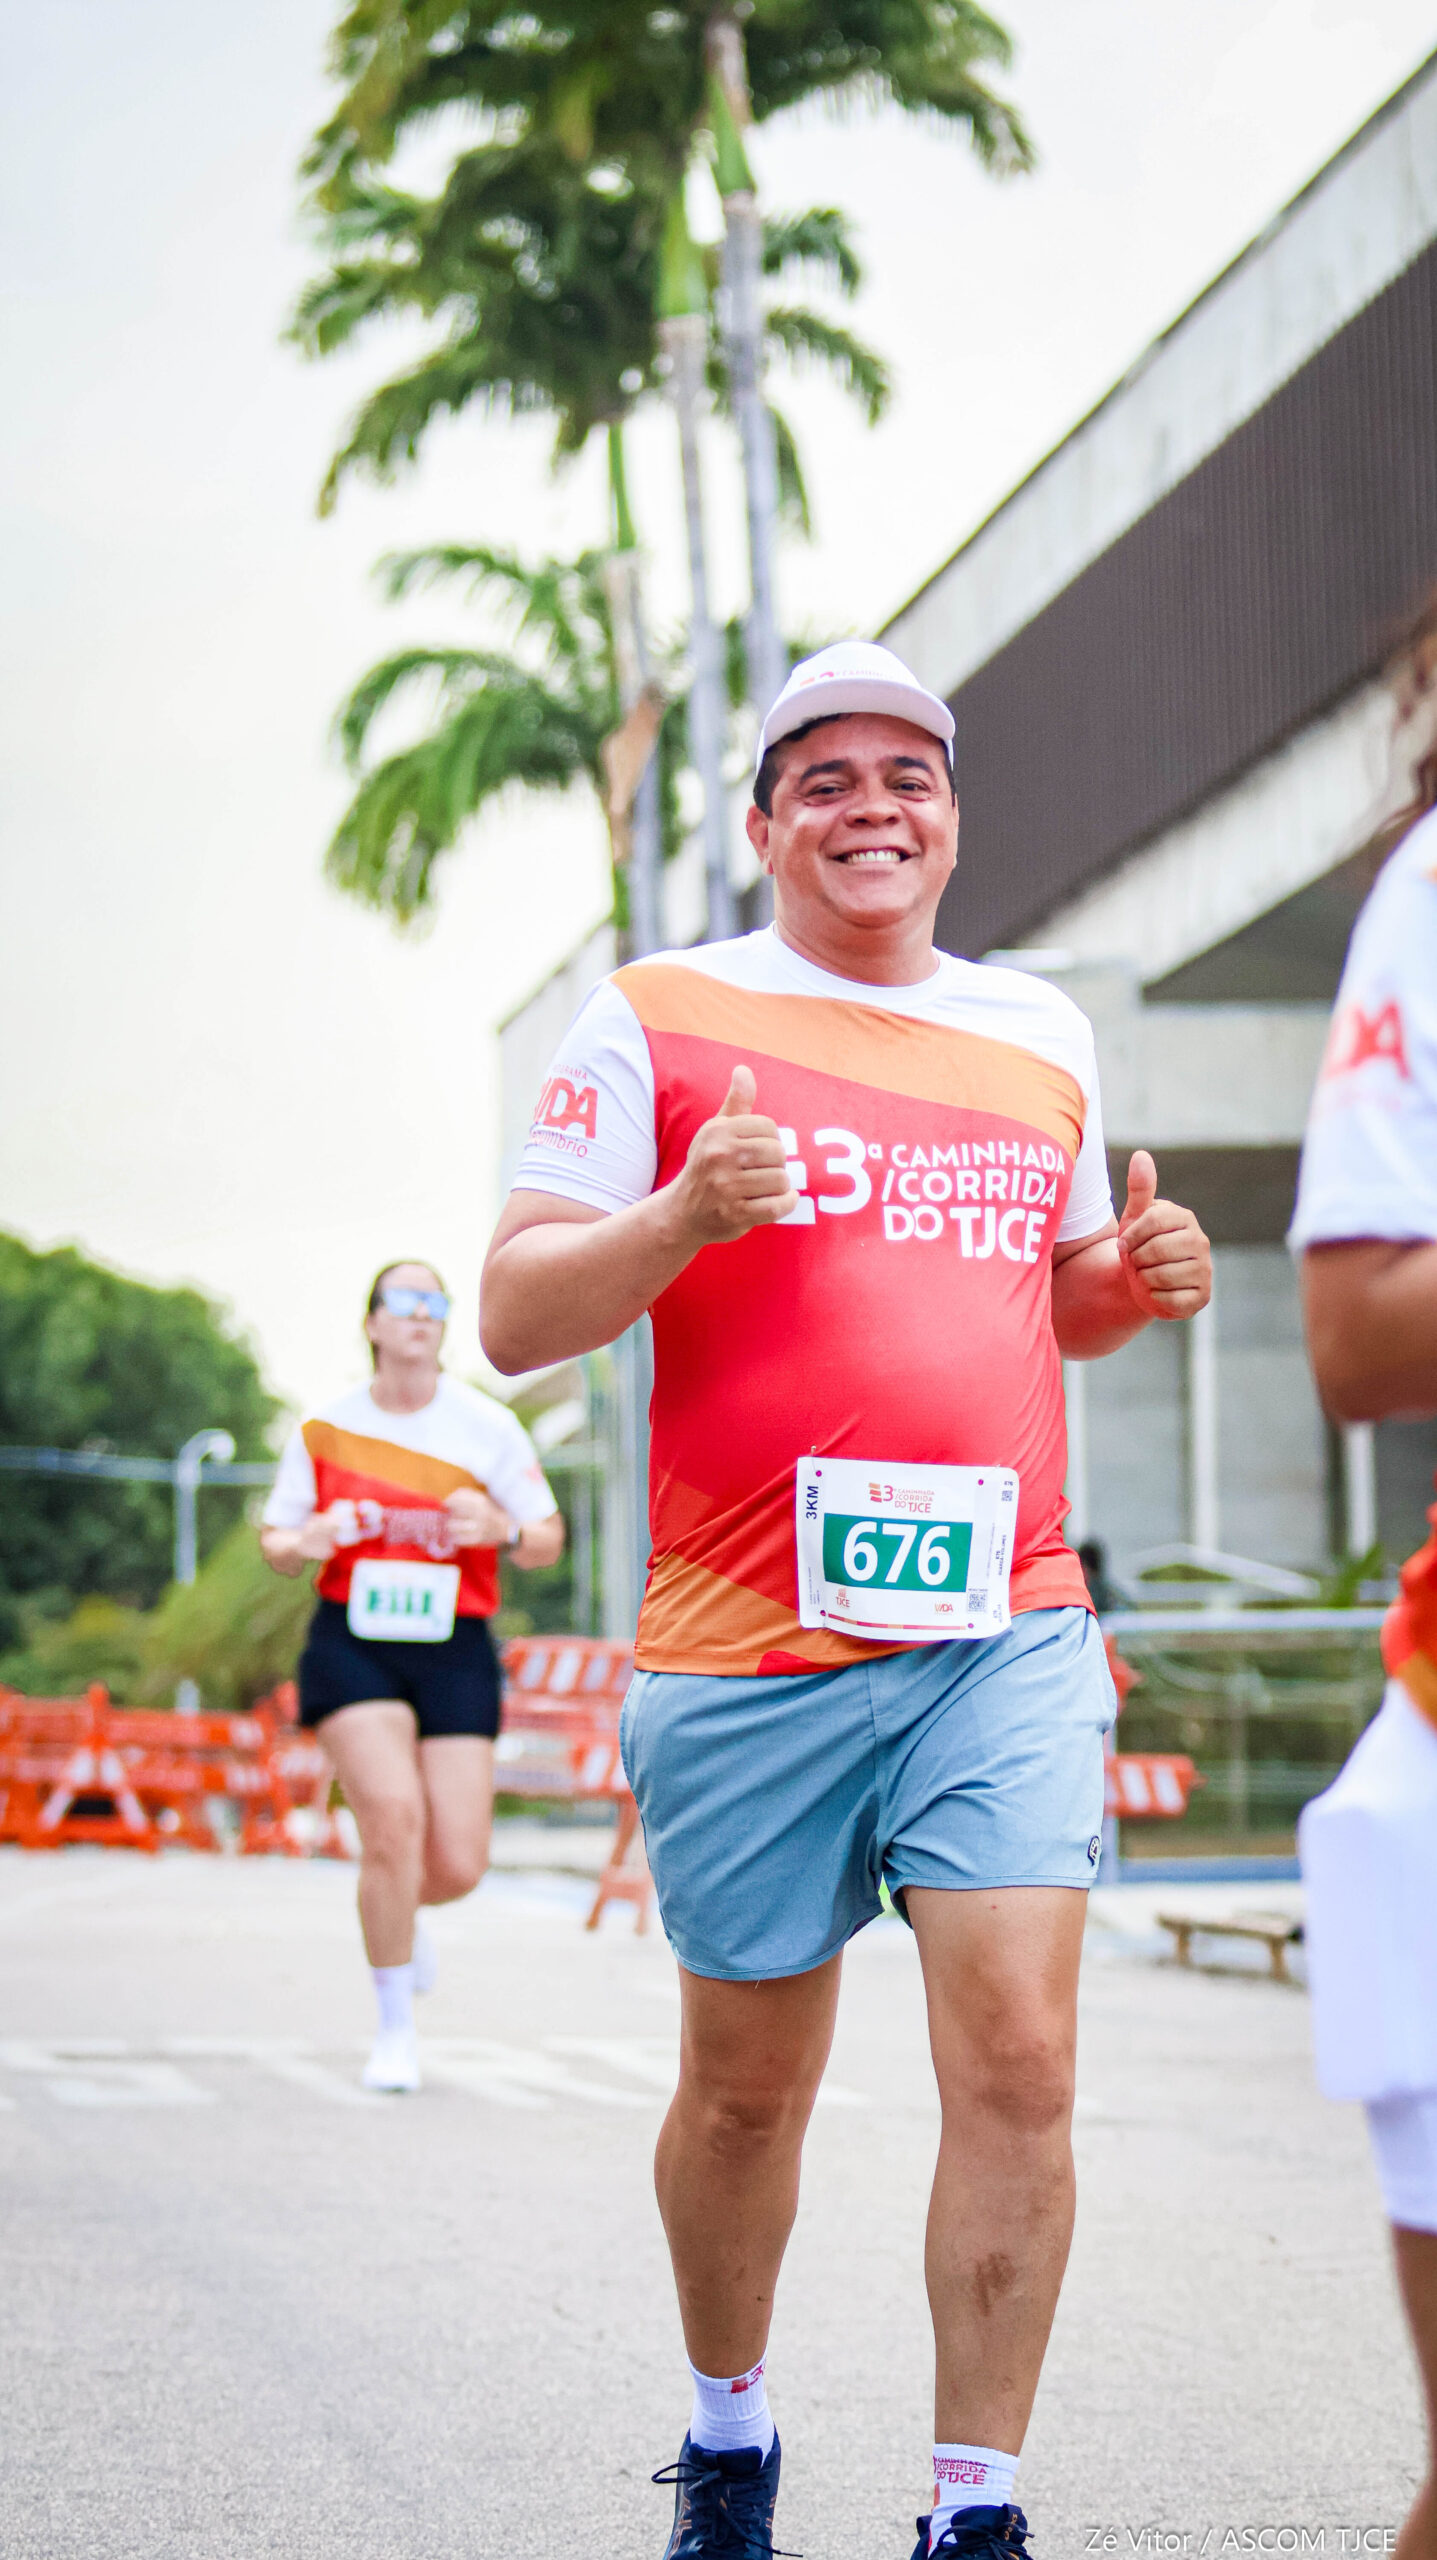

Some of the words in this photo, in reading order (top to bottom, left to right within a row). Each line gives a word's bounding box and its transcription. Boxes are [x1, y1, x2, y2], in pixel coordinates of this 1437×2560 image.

[890, 1141, 1066, 1175] CAMINHADA
[883, 1205, 944, 1241] DO
[950, 1206, 1048, 1264] TJCE
[806, 1486, 820, 1519] 3KM
[908, 1502, 932, 1513] TJCE
[843, 1521, 951, 1586] 676
[947, 2471, 985, 2485] TJCE
